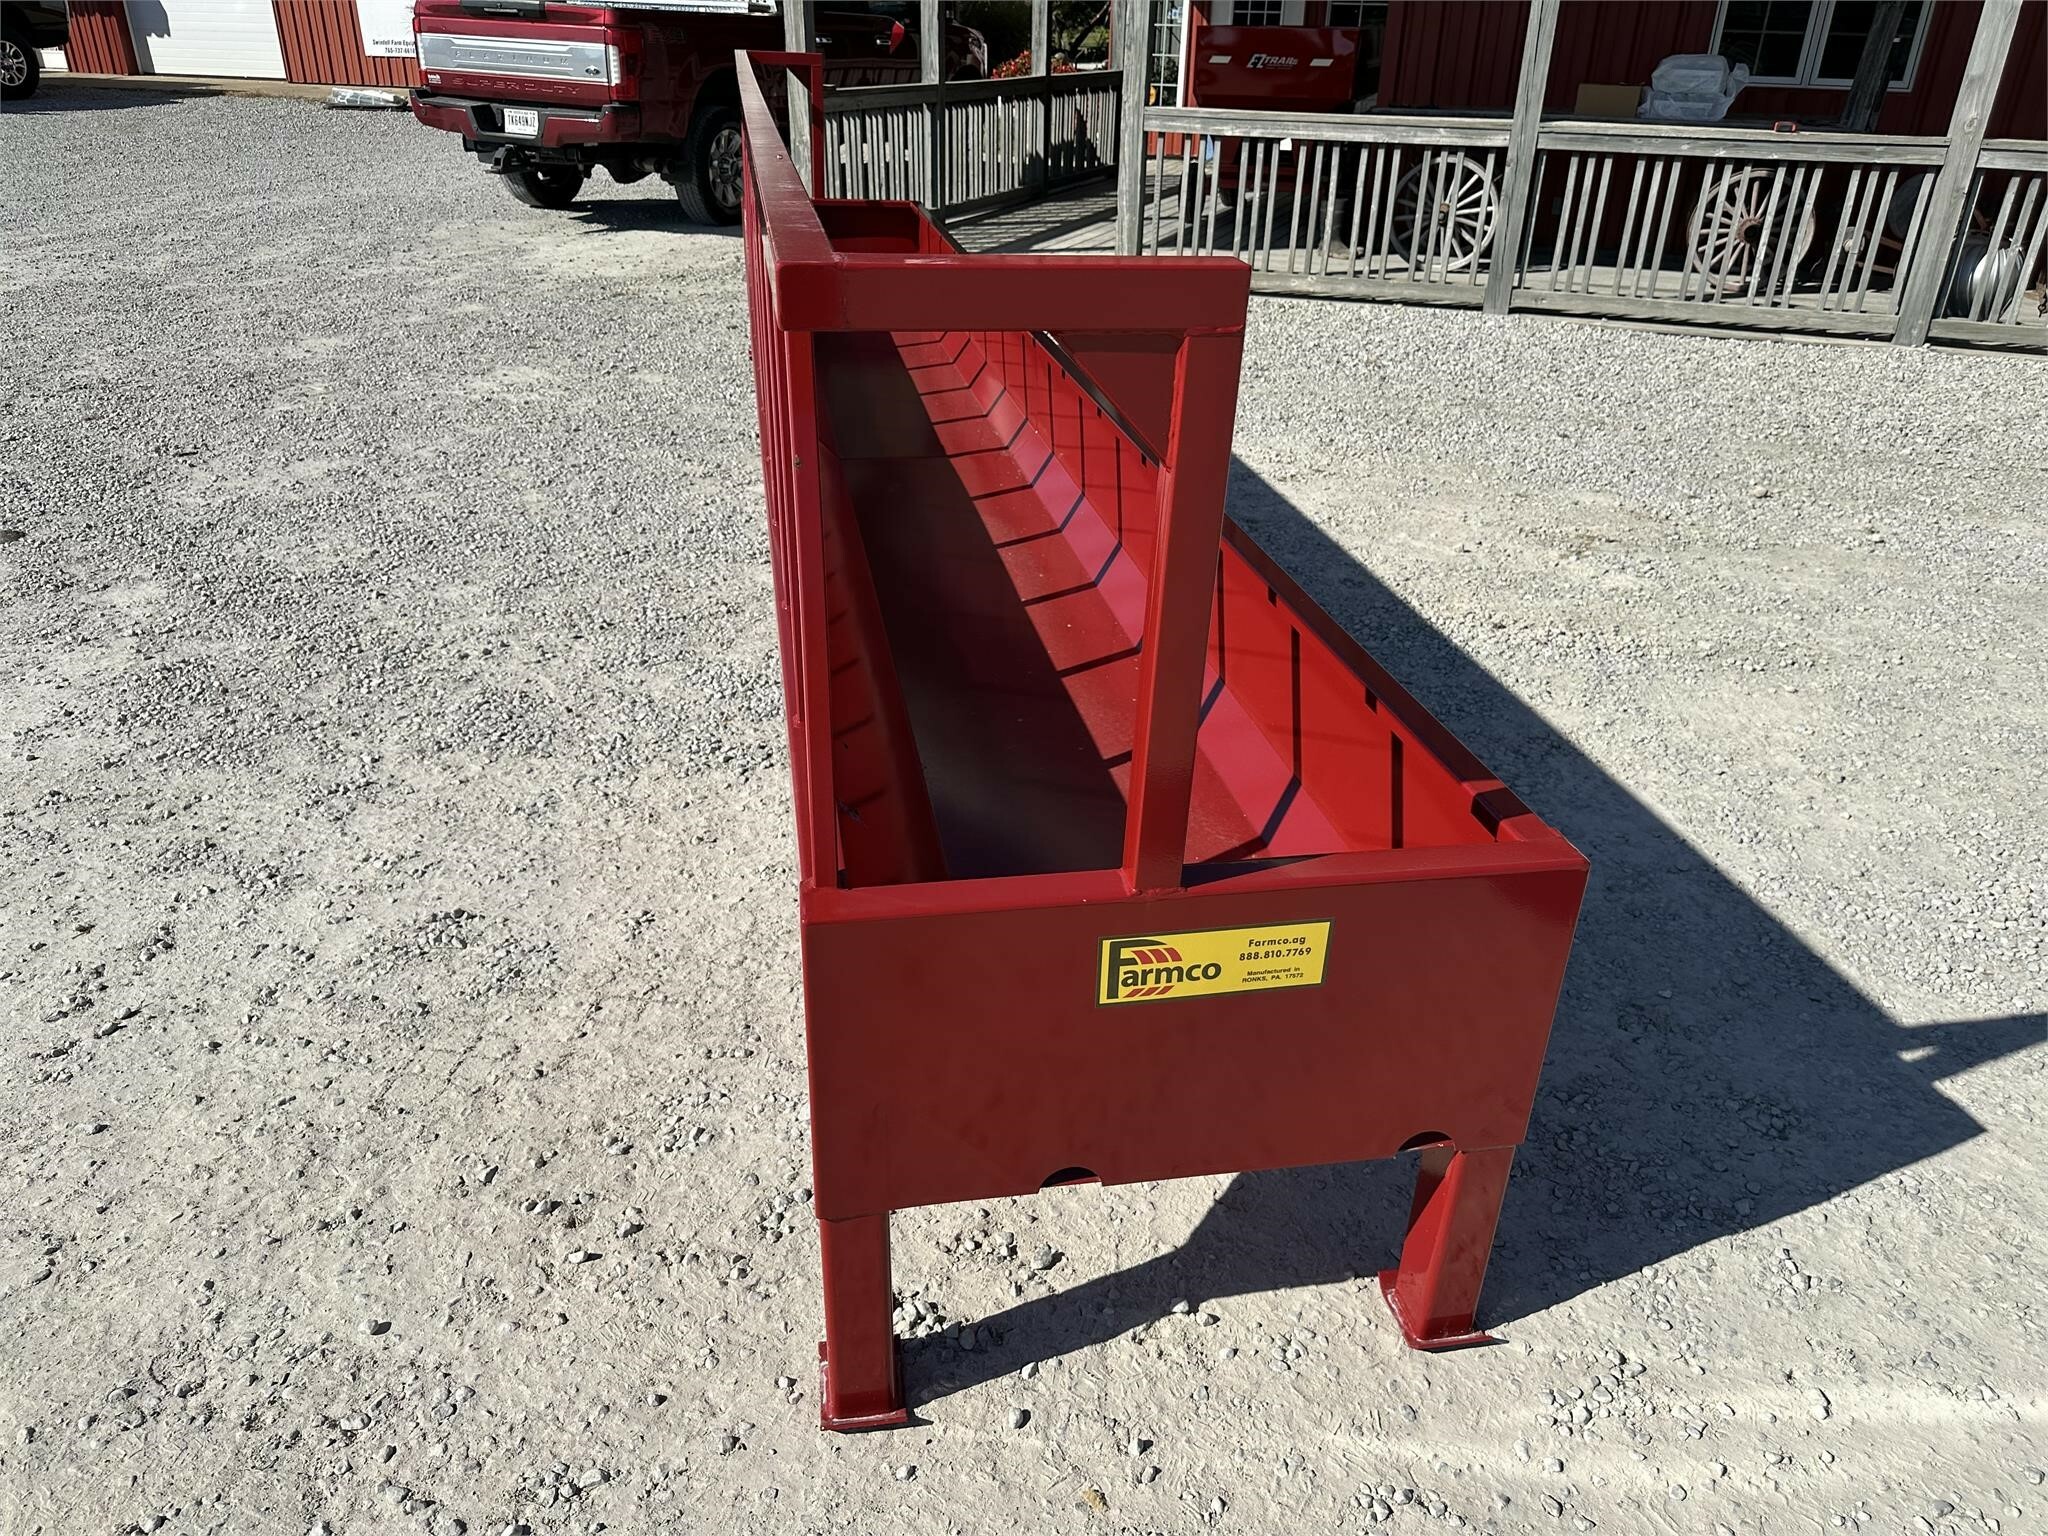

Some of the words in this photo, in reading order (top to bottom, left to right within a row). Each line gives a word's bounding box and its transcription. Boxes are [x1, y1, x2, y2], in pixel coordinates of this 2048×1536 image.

[455, 50, 569, 66] PLATINUM
[452, 77, 519, 90] SUPER
[523, 82, 580, 94] DUTY
[1248, 936, 1306, 947] Farmco.ag
[1239, 947, 1312, 961] 888.810.7769
[1106, 939, 1222, 1000] Farmco
[1247, 967, 1291, 976] Manufactured
